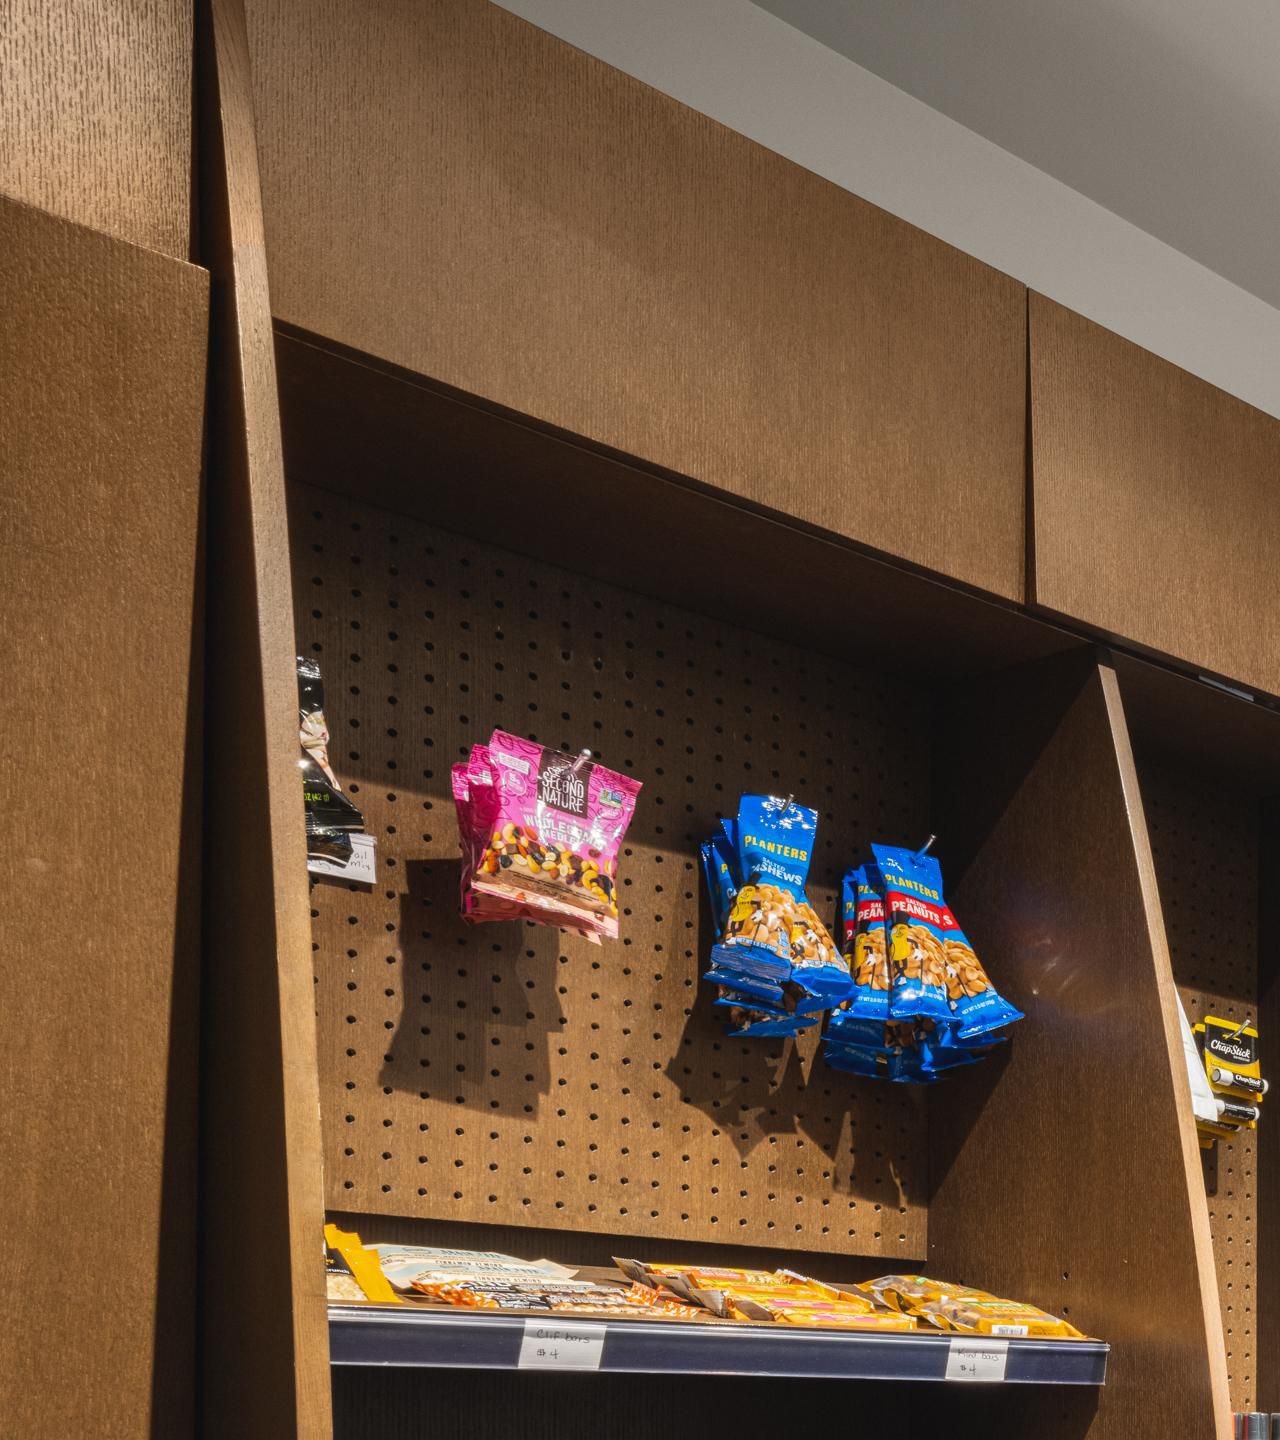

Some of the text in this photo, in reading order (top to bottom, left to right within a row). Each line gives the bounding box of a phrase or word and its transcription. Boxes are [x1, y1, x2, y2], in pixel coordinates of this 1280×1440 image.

[542, 787, 584, 813] NATURE
[744, 836, 808, 861] PLANTERS
[885, 874, 939, 900] PLANTERS
[892, 901, 940, 925] PEANUTS
[1211, 1039, 1250, 1058] ChapStick
